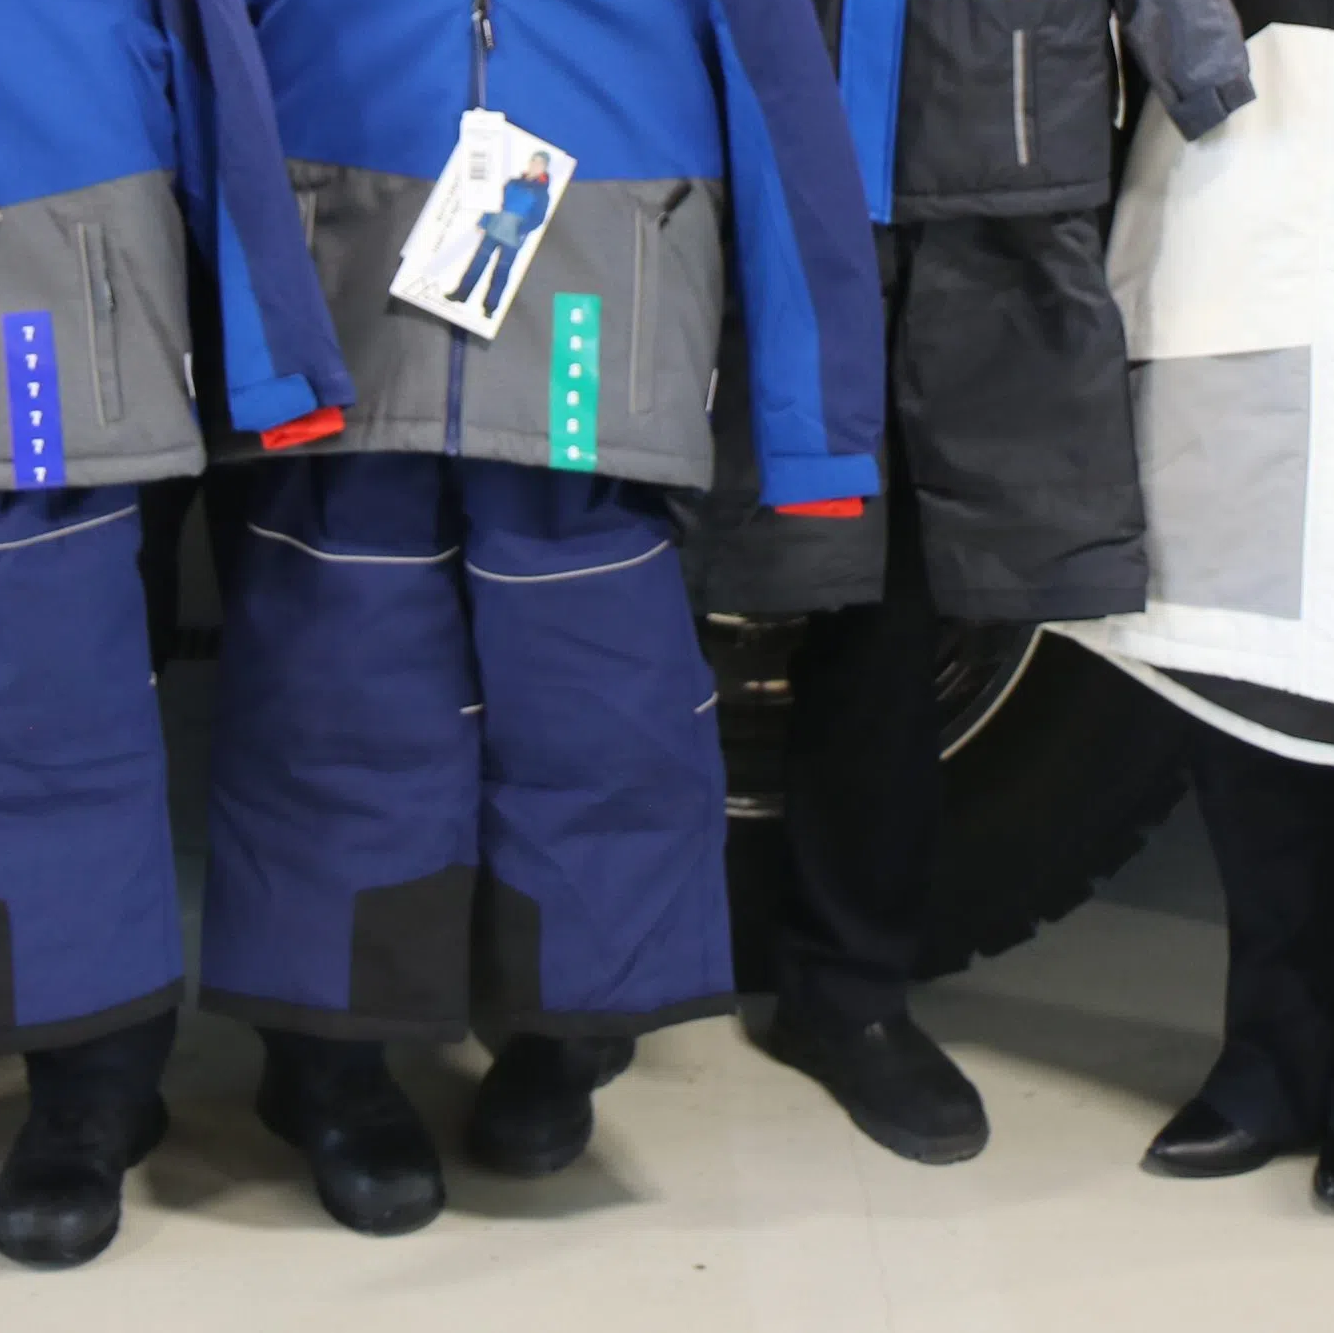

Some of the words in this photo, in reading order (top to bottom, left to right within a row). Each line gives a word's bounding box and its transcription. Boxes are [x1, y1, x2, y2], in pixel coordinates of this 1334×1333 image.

[22, 325, 35, 342] 7
[25, 353, 38, 370] 7
[27, 381, 40, 398] 7
[29, 410, 42, 427] 7
[31, 438, 45, 455] 7
[33, 466, 46, 483] 7
